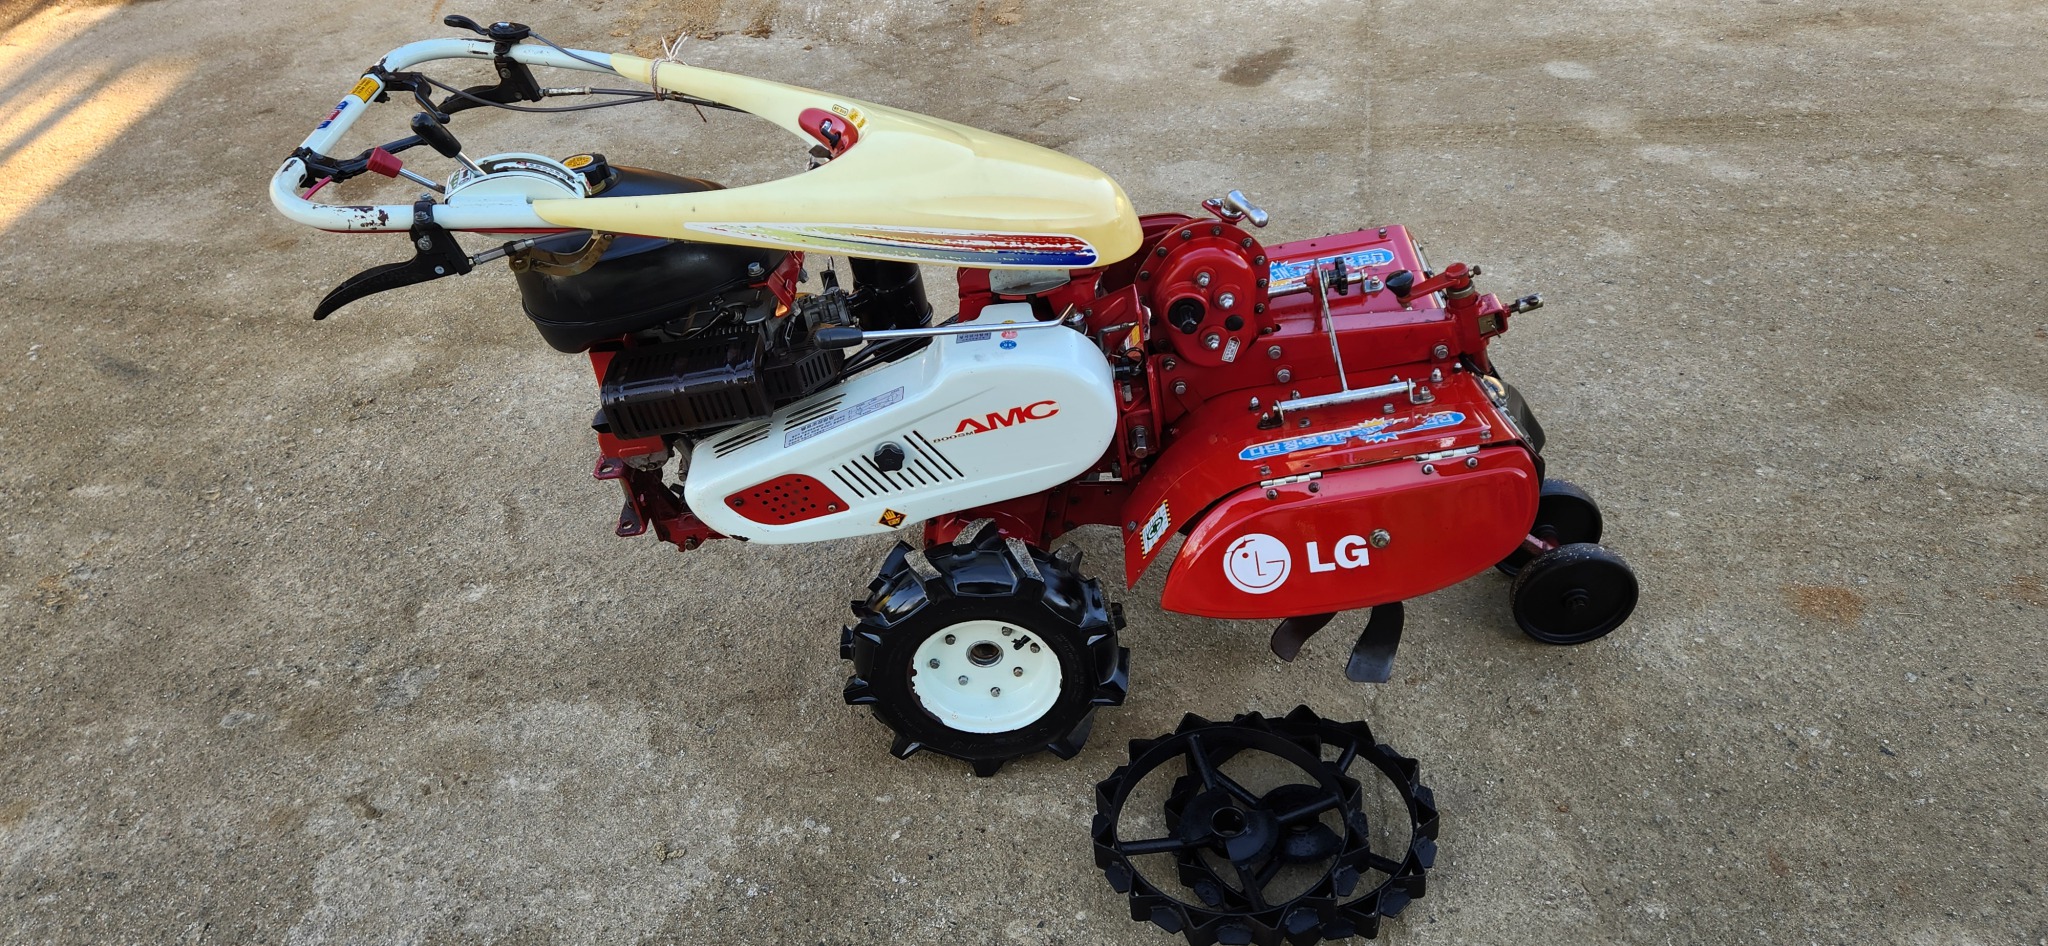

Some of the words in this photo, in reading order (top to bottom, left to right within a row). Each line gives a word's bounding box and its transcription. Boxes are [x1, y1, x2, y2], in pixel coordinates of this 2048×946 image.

[954, 400, 1060, 434] AMC
[1249, 442, 1281, 457] 다단
[1306, 534, 1370, 573] LG
